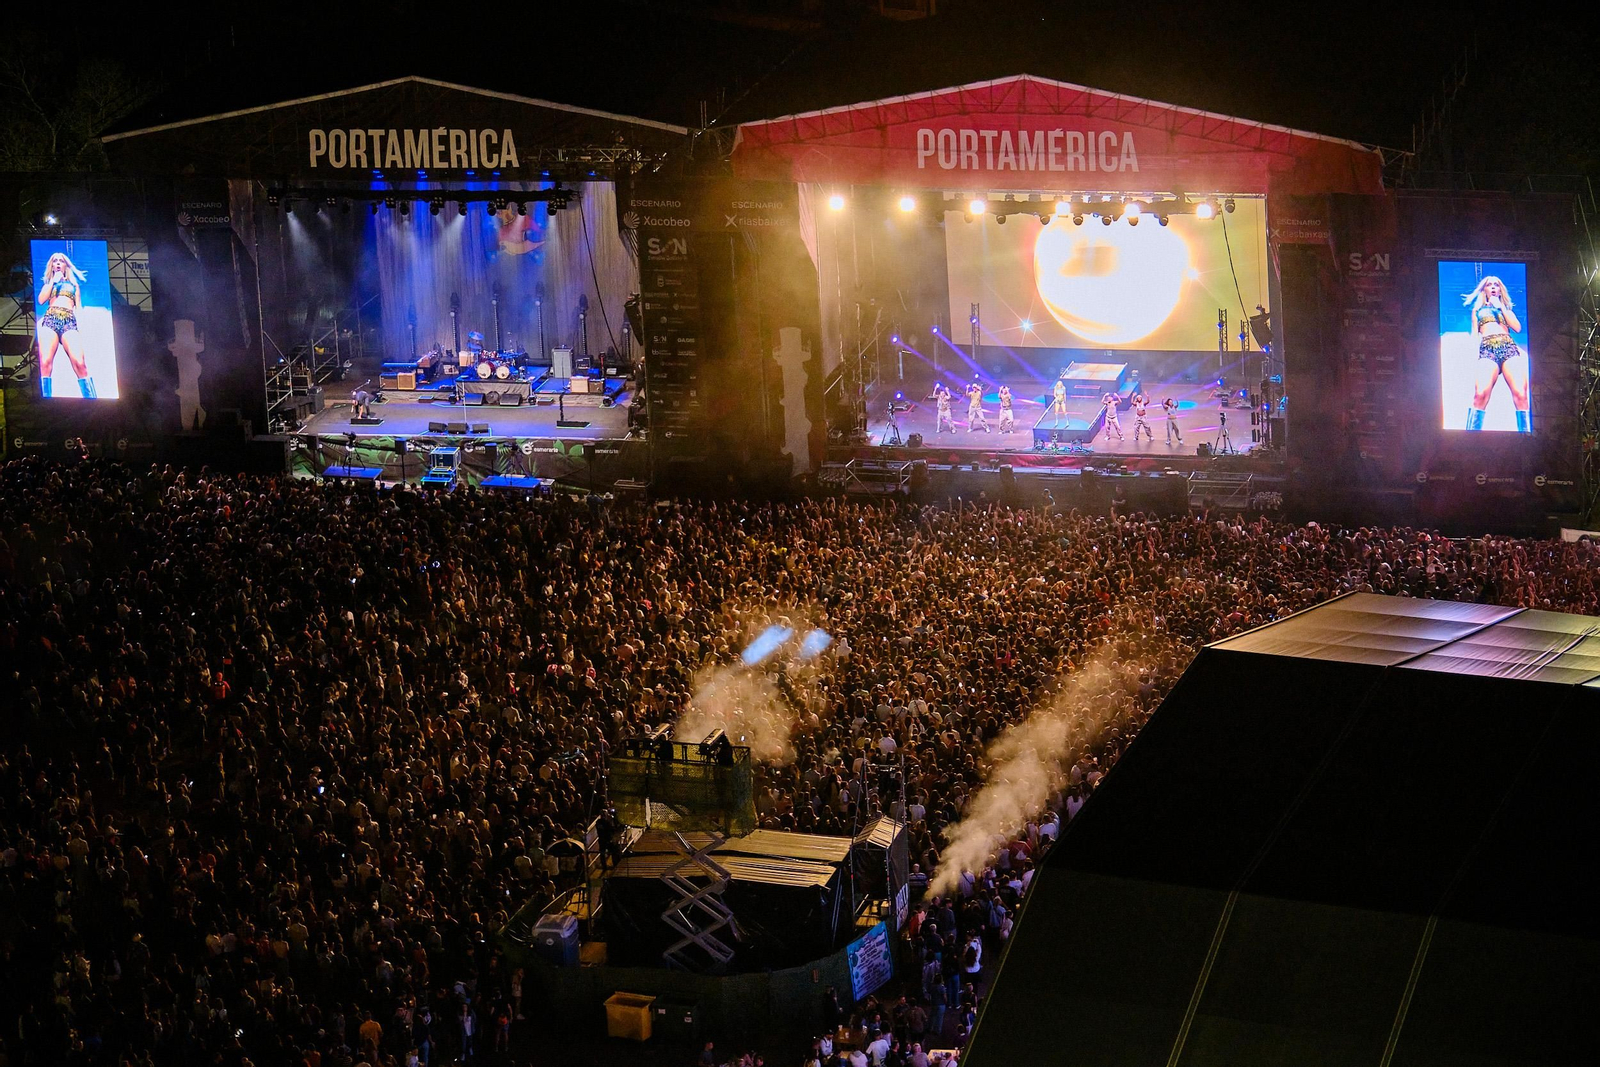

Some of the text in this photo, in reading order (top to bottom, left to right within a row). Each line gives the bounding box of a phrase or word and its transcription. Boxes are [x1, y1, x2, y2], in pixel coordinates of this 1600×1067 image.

[309, 126, 520, 169] PORTAMÉRICA
[917, 128, 1140, 172] PORTAMÉRICA
[630, 199, 681, 208] ESCENARIO
[731, 201, 783, 210] ESCENARIO
[193, 215, 230, 223] Xacobeo
[643, 215, 691, 227] Xacobeo
[1276, 218, 1322, 226] ESCENARIO
